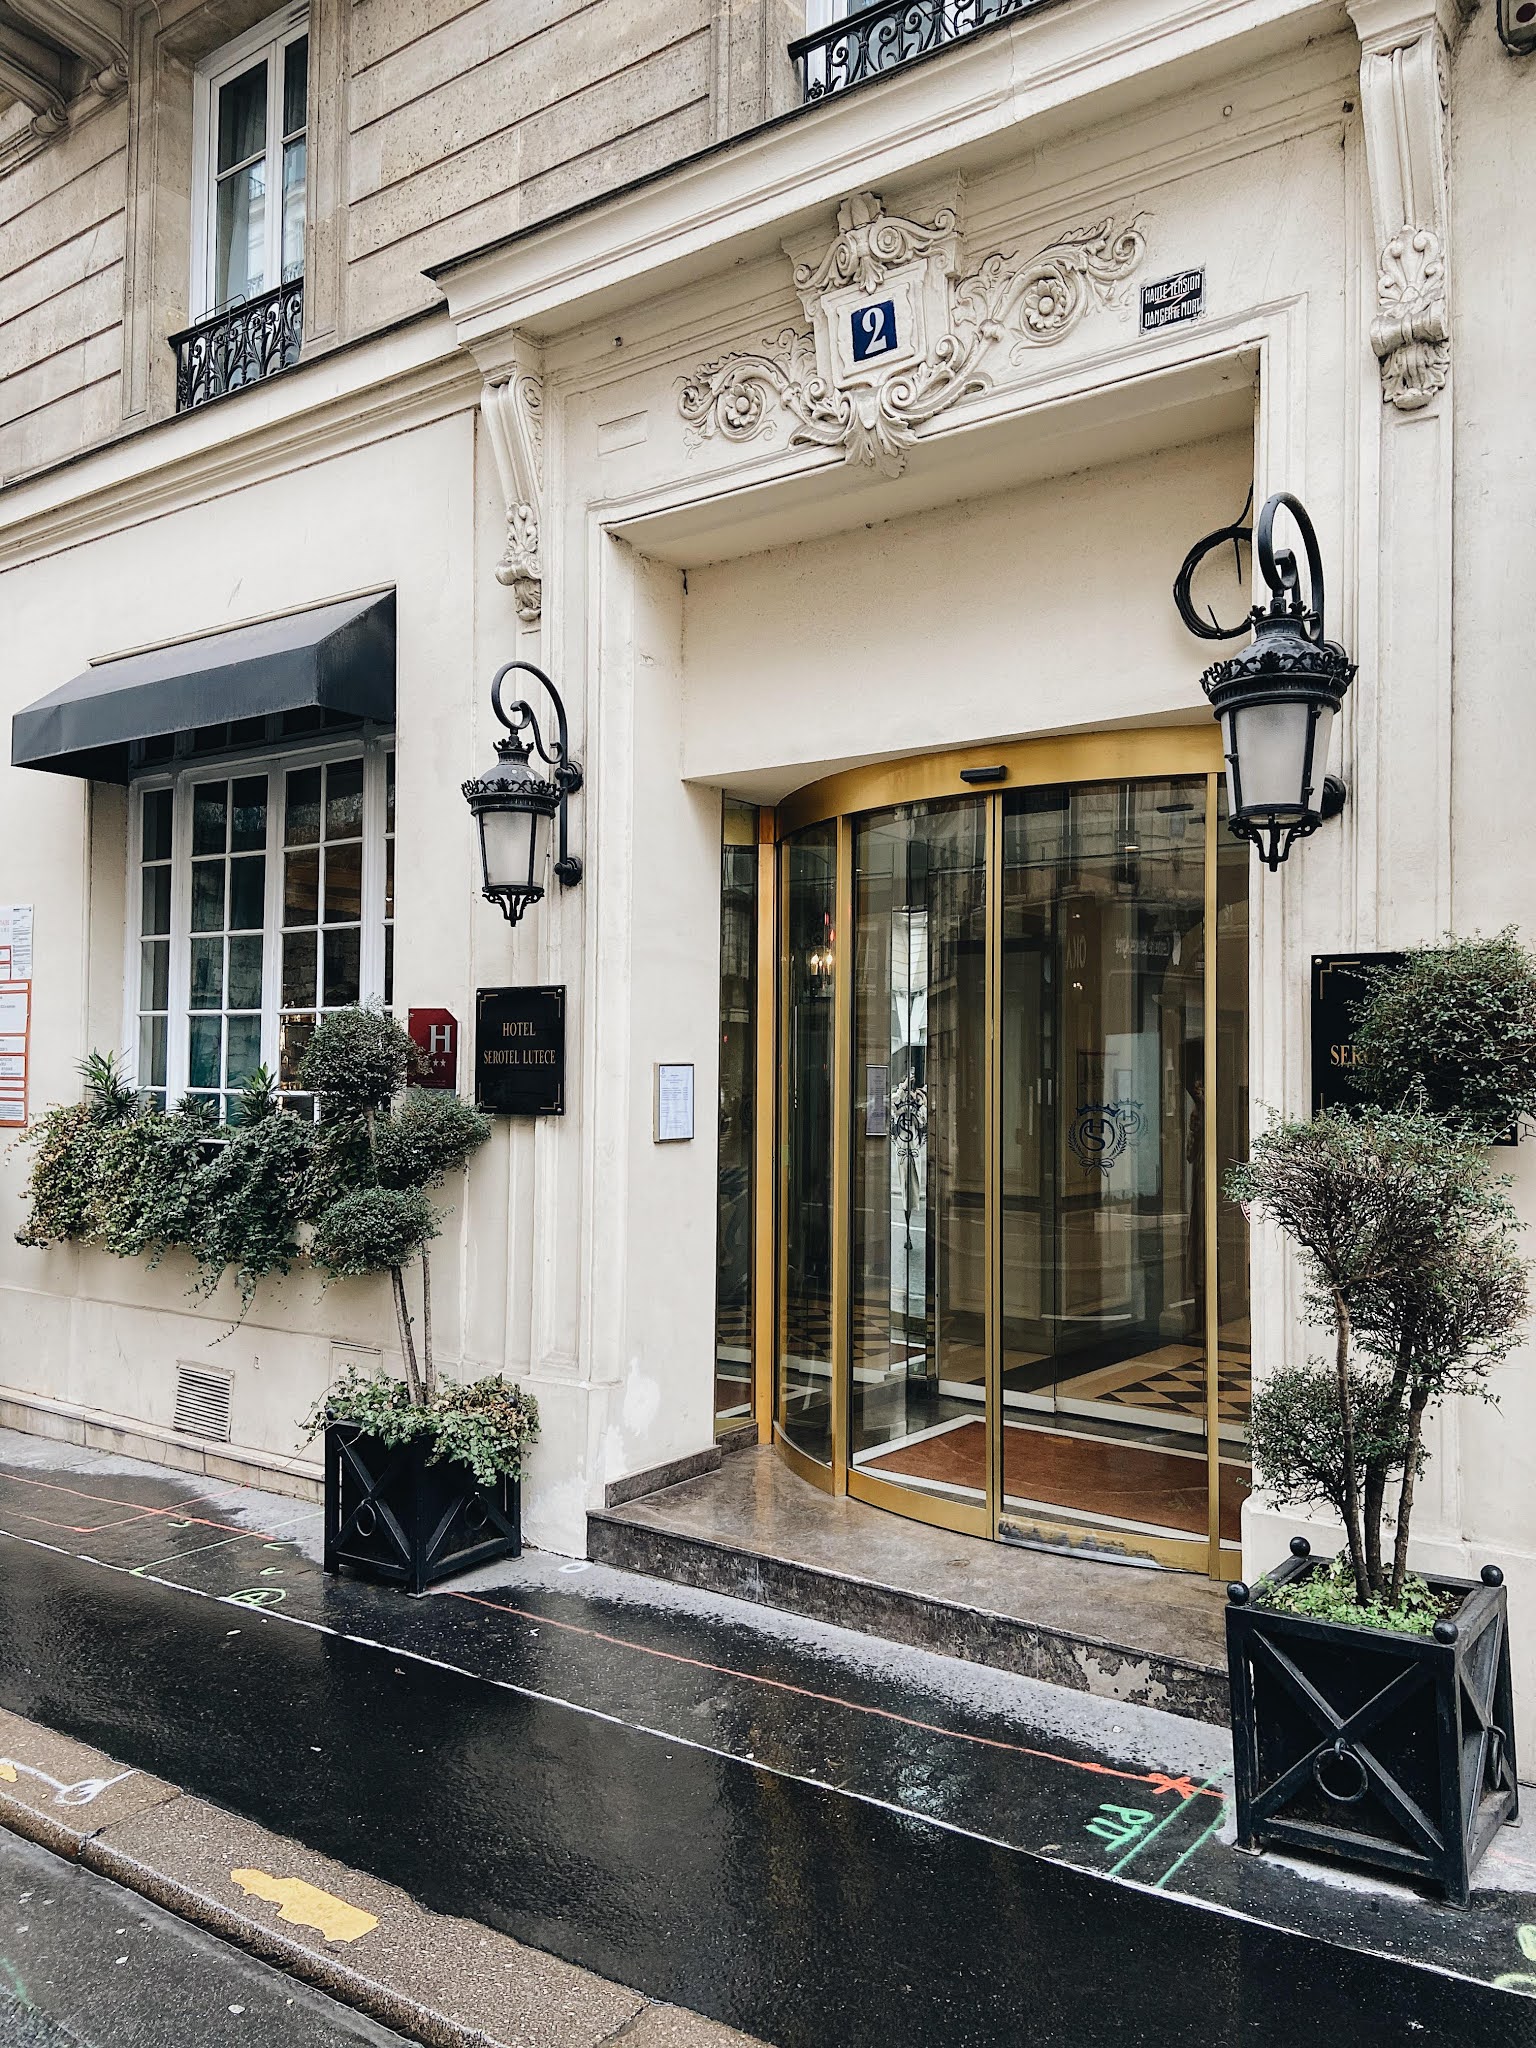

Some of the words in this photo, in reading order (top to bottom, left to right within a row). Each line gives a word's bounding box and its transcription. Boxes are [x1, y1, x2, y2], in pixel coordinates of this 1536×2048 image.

[1145, 284, 1168, 304] HAUTE
[1170, 274, 1201, 296] TENSION
[1144, 306, 1173, 327] DANGER
[1181, 297, 1202, 317] MORT
[862, 307, 887, 355] 2
[428, 1024, 453, 1054] H
[502, 1022, 536, 1036] HOTEL
[483, 1050, 520, 1065] SEROTEL
[522, 1050, 556, 1065] LUTECE
